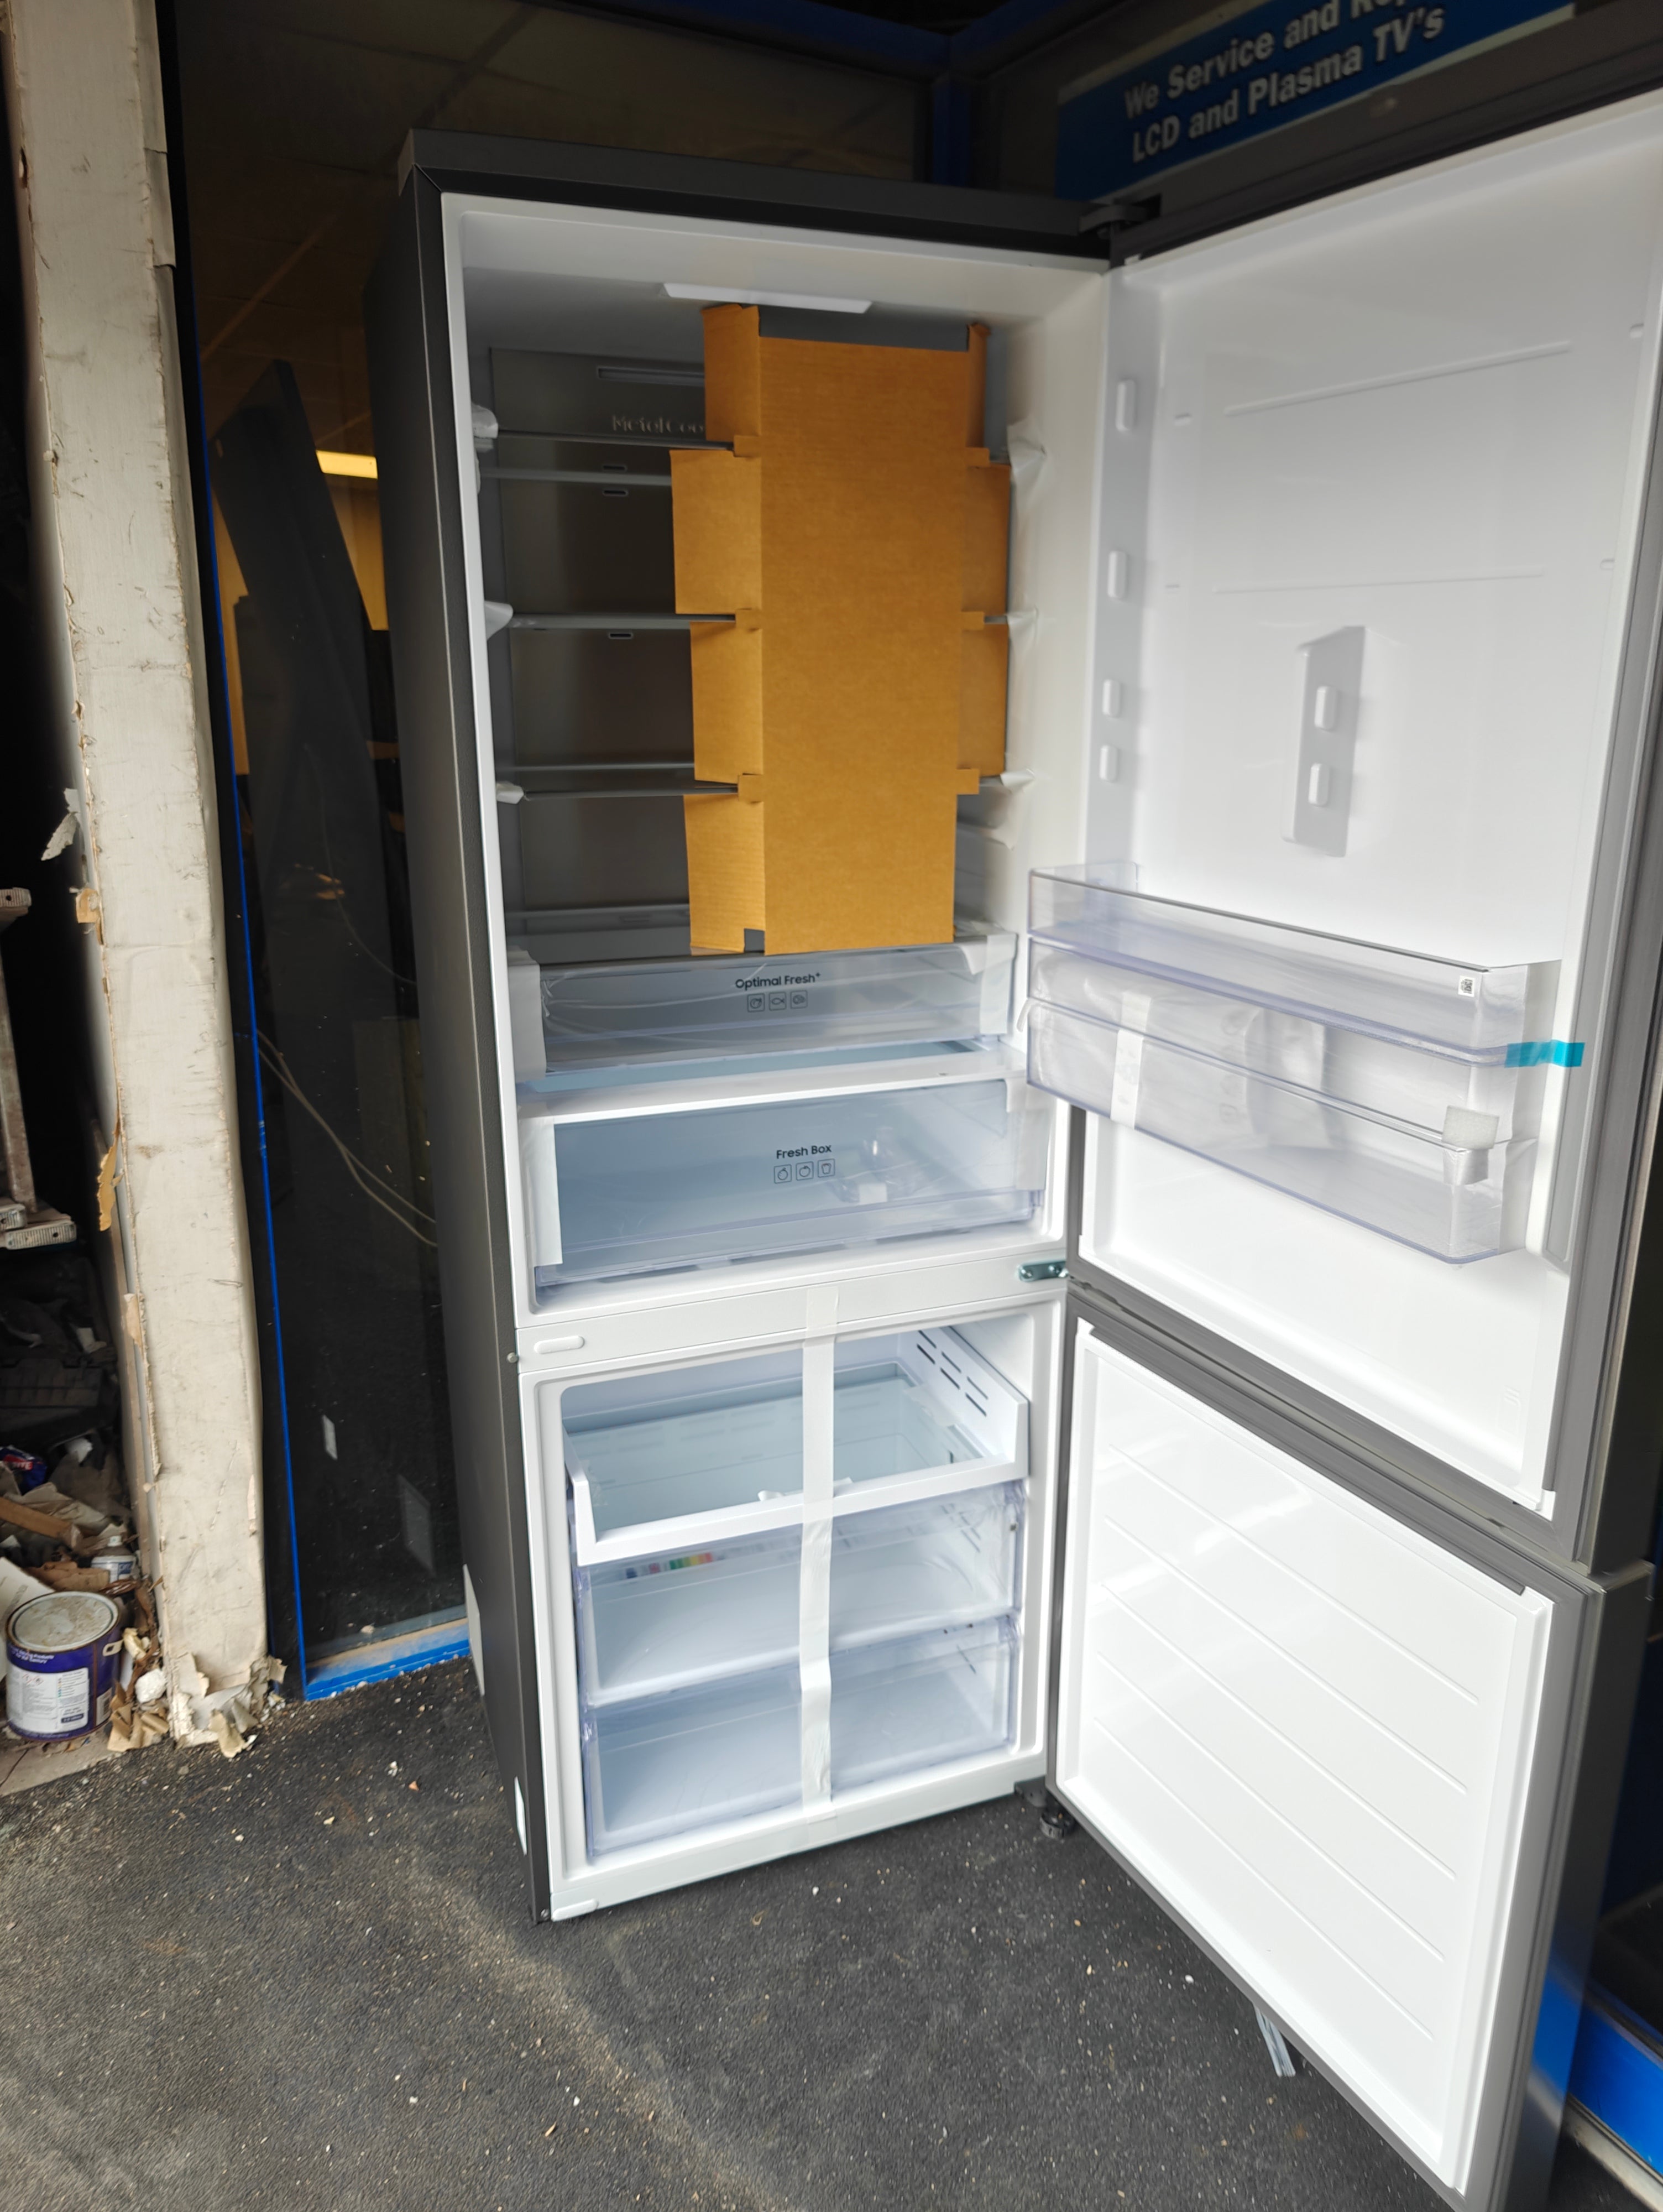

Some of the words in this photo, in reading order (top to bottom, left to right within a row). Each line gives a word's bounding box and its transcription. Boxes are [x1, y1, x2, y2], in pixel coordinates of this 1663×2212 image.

[1124, 81, 1159, 118] We
[1167, 32, 1275, 99] Service
[1284, 0, 1340, 49] and
[1132, 114, 1180, 163] LCD
[1188, 88, 1239, 139] and
[1247, 44, 1364, 115] Plasma
[1372, 7, 1445, 62] TV's
[735, 976, 782, 991] Optimal
[776, 1147, 808, 1159] Fresh
[811, 1145, 832, 1155] Box
